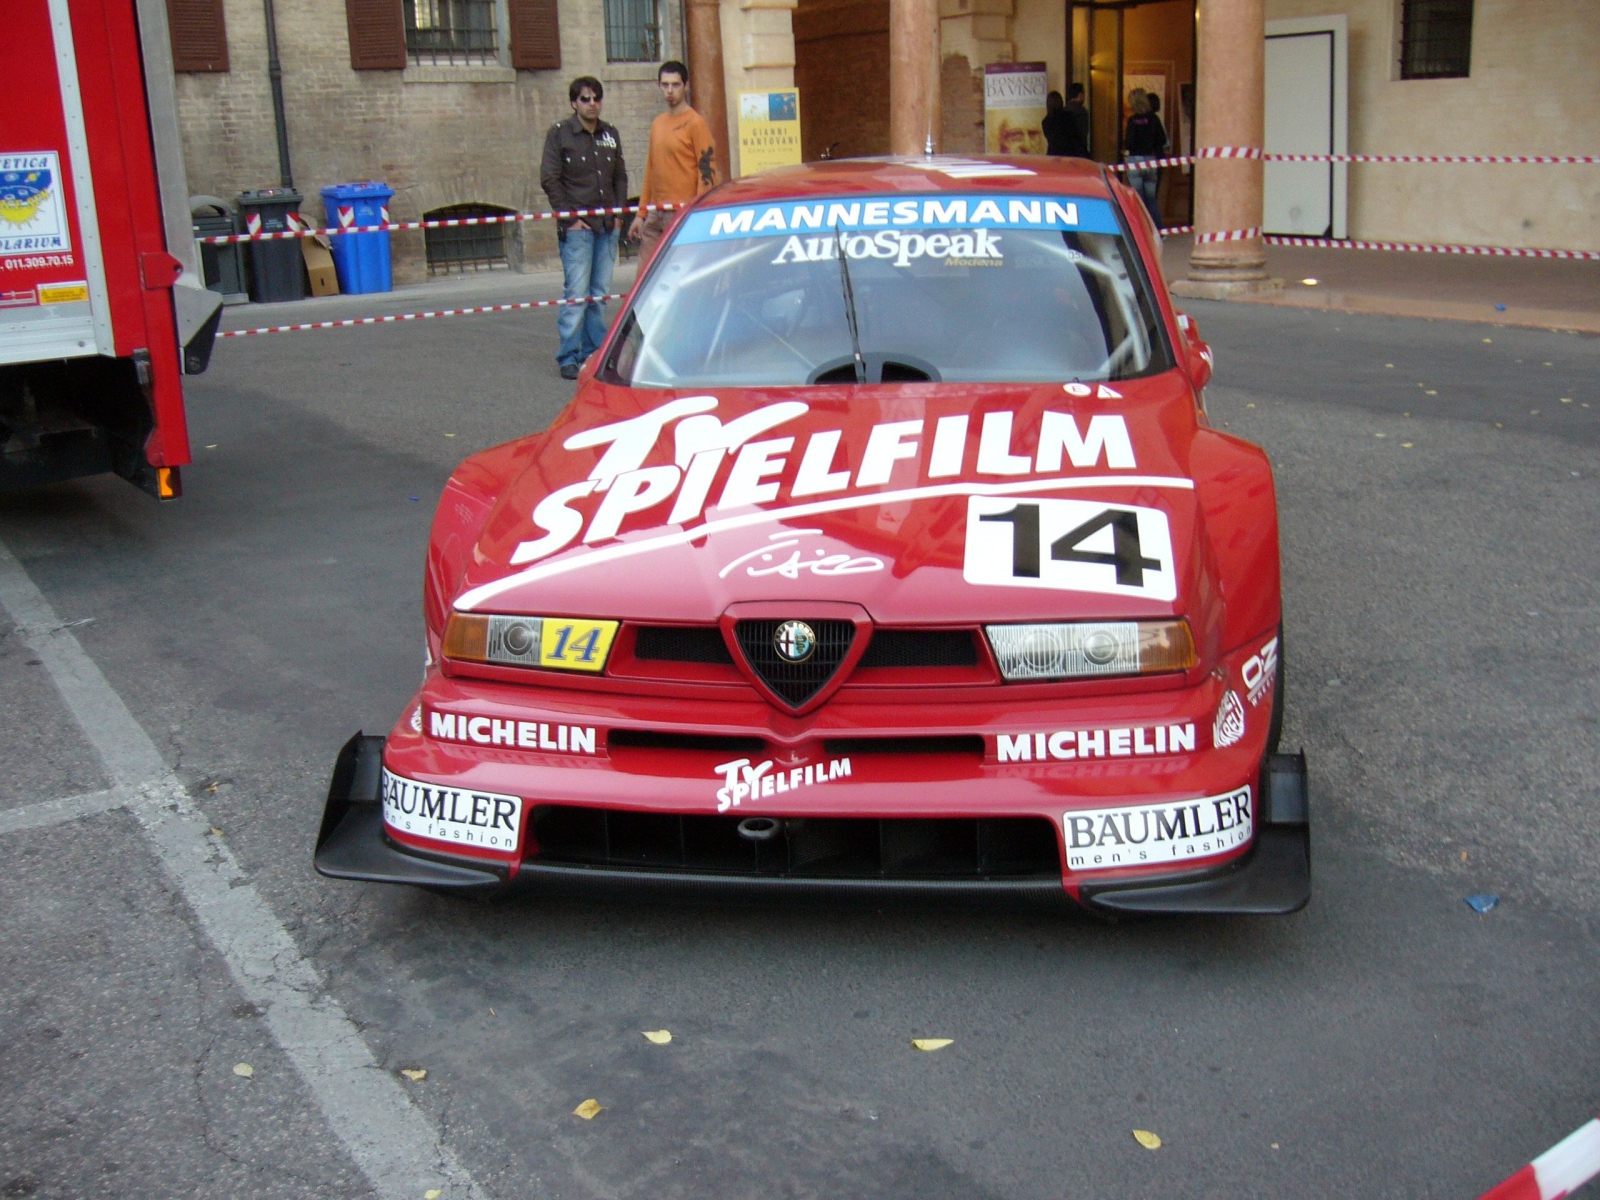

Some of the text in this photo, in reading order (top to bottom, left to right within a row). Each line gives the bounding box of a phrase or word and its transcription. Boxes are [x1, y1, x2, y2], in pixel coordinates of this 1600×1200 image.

[752, 128, 787, 136] GIANNI
[709, 199, 1079, 236] MANNESMANN
[771, 228, 1004, 266] AutoSpeak
[945, 257, 1004, 267] Modena
[563, 396, 810, 492] TV
[509, 409, 1138, 566] SPIELFILM
[979, 503, 1162, 588] 14
[546, 624, 604, 663] 14
[430, 711, 597, 755] MICHELIN
[997, 723, 1196, 762] MICHELIN
[714, 758, 774, 791] TV
[716, 757, 852, 813] SPIELFILM
[383, 769, 516, 831] BÄUMLER
[1068, 790, 1251, 849] BÄUMLER
[428, 823, 513, 848] fashion
[1070, 826, 1252, 866] men's fashion
